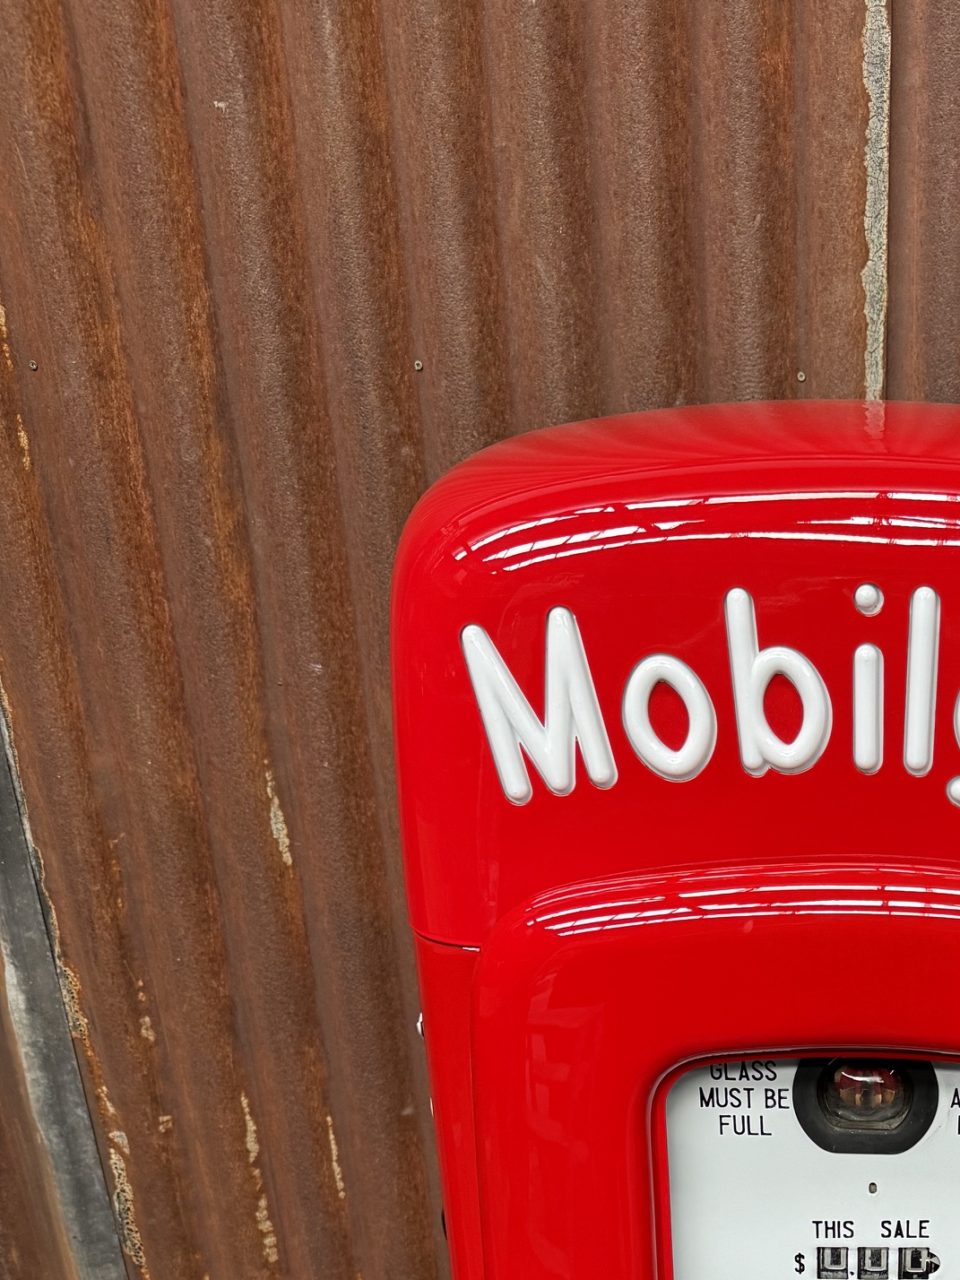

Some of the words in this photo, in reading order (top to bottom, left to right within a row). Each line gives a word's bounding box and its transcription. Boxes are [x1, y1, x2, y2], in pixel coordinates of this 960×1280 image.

[709, 1061, 778, 1082] GLASS
[698, 1086, 755, 1109] MUST
[764, 1088, 791, 1110] BE
[718, 1114, 773, 1137] FULL
[811, 1220, 855, 1240] THIS
[880, 1219, 931, 1239] SALE
